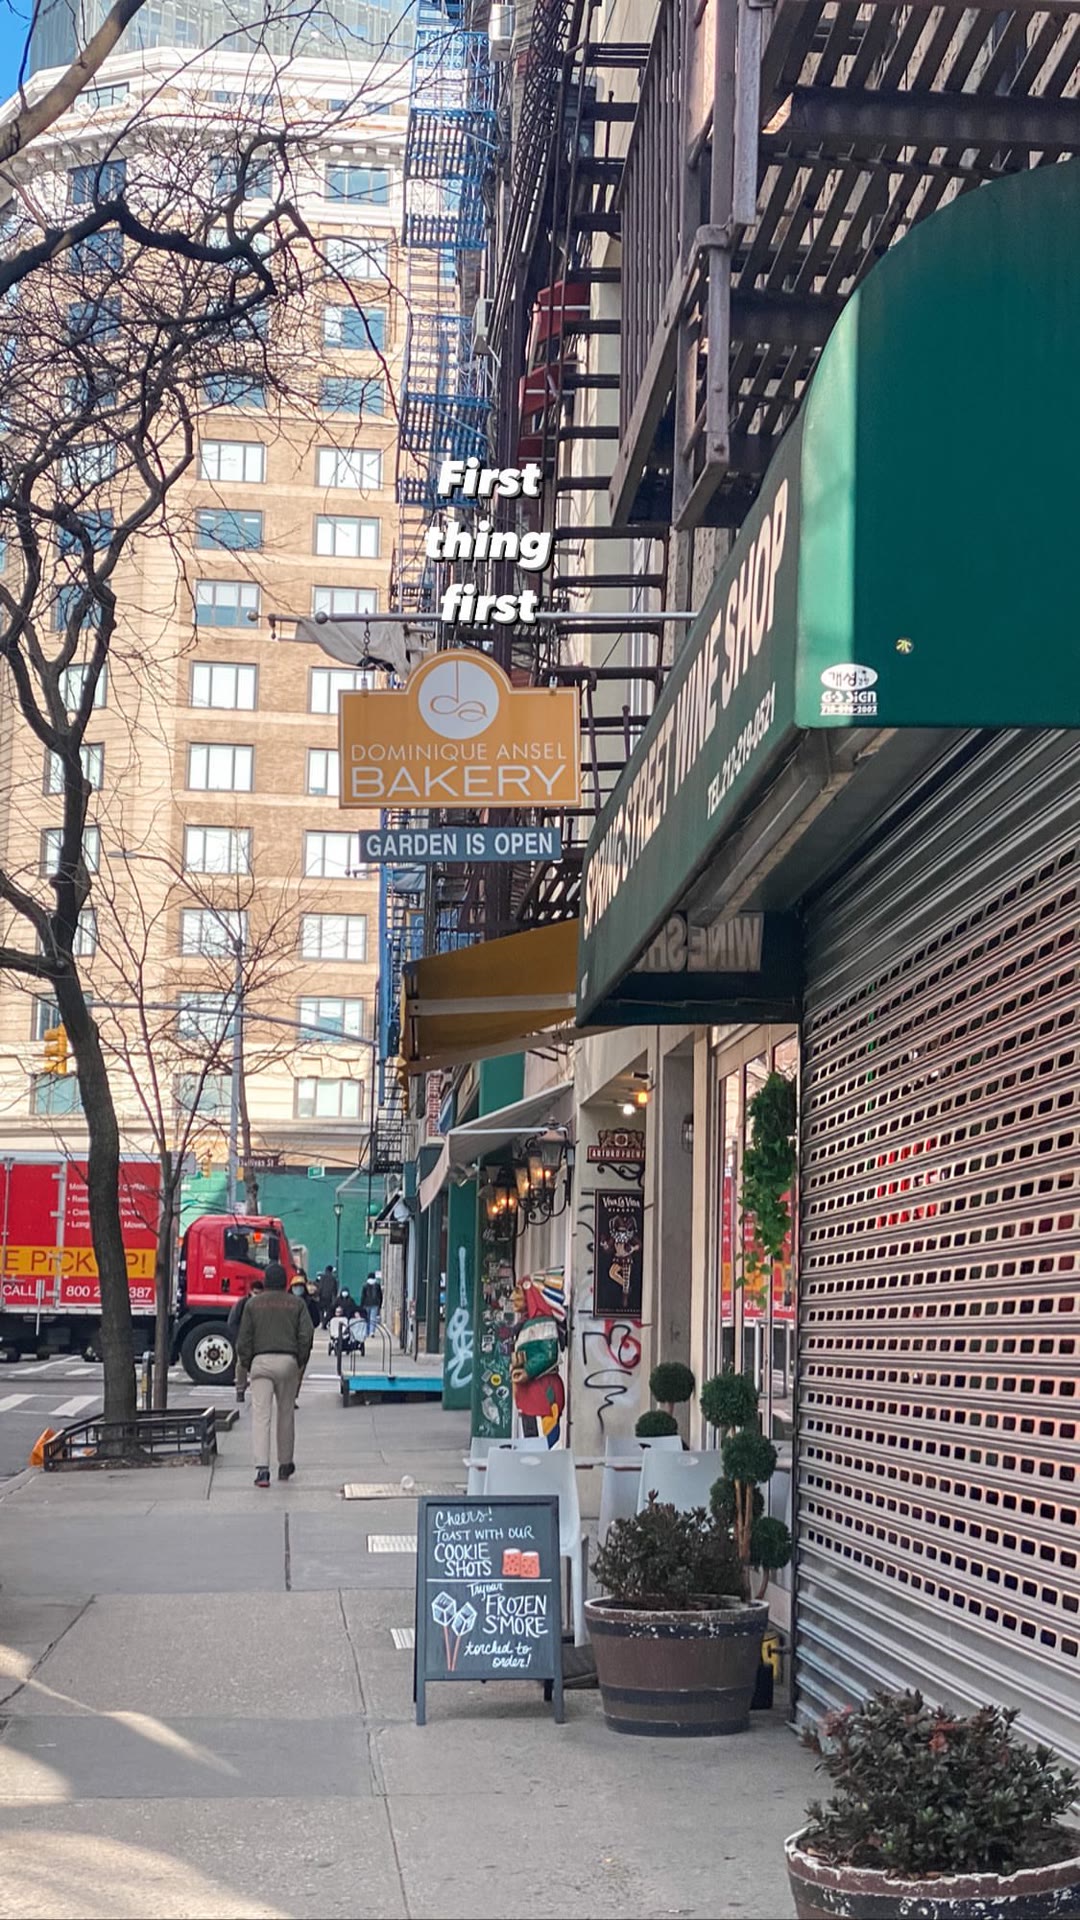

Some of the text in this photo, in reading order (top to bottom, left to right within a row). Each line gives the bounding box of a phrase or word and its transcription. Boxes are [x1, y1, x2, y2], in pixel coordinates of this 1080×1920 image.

[583, 478, 789, 941] SPRING STREET WINE SHOP
[351, 742, 567, 761] DOMINIQUE ANSEL
[351, 764, 567, 798] BAKERY
[366, 832, 553, 857] GARDEN IS OPEN
[30, 1250, 147, 1274] PICKP!
[65, 1285, 91, 1297] 800
[435, 1506, 493, 1529] Cheers!
[433, 1525, 535, 1542] TOAST WITH OUR
[434, 1542, 491, 1562] COOKIE
[444, 1560, 493, 1577] SHOTS
[485, 1593, 547, 1617] FROZEN
[464, 1641, 532, 1657] torched to
[492, 1653, 532, 1669] order!
